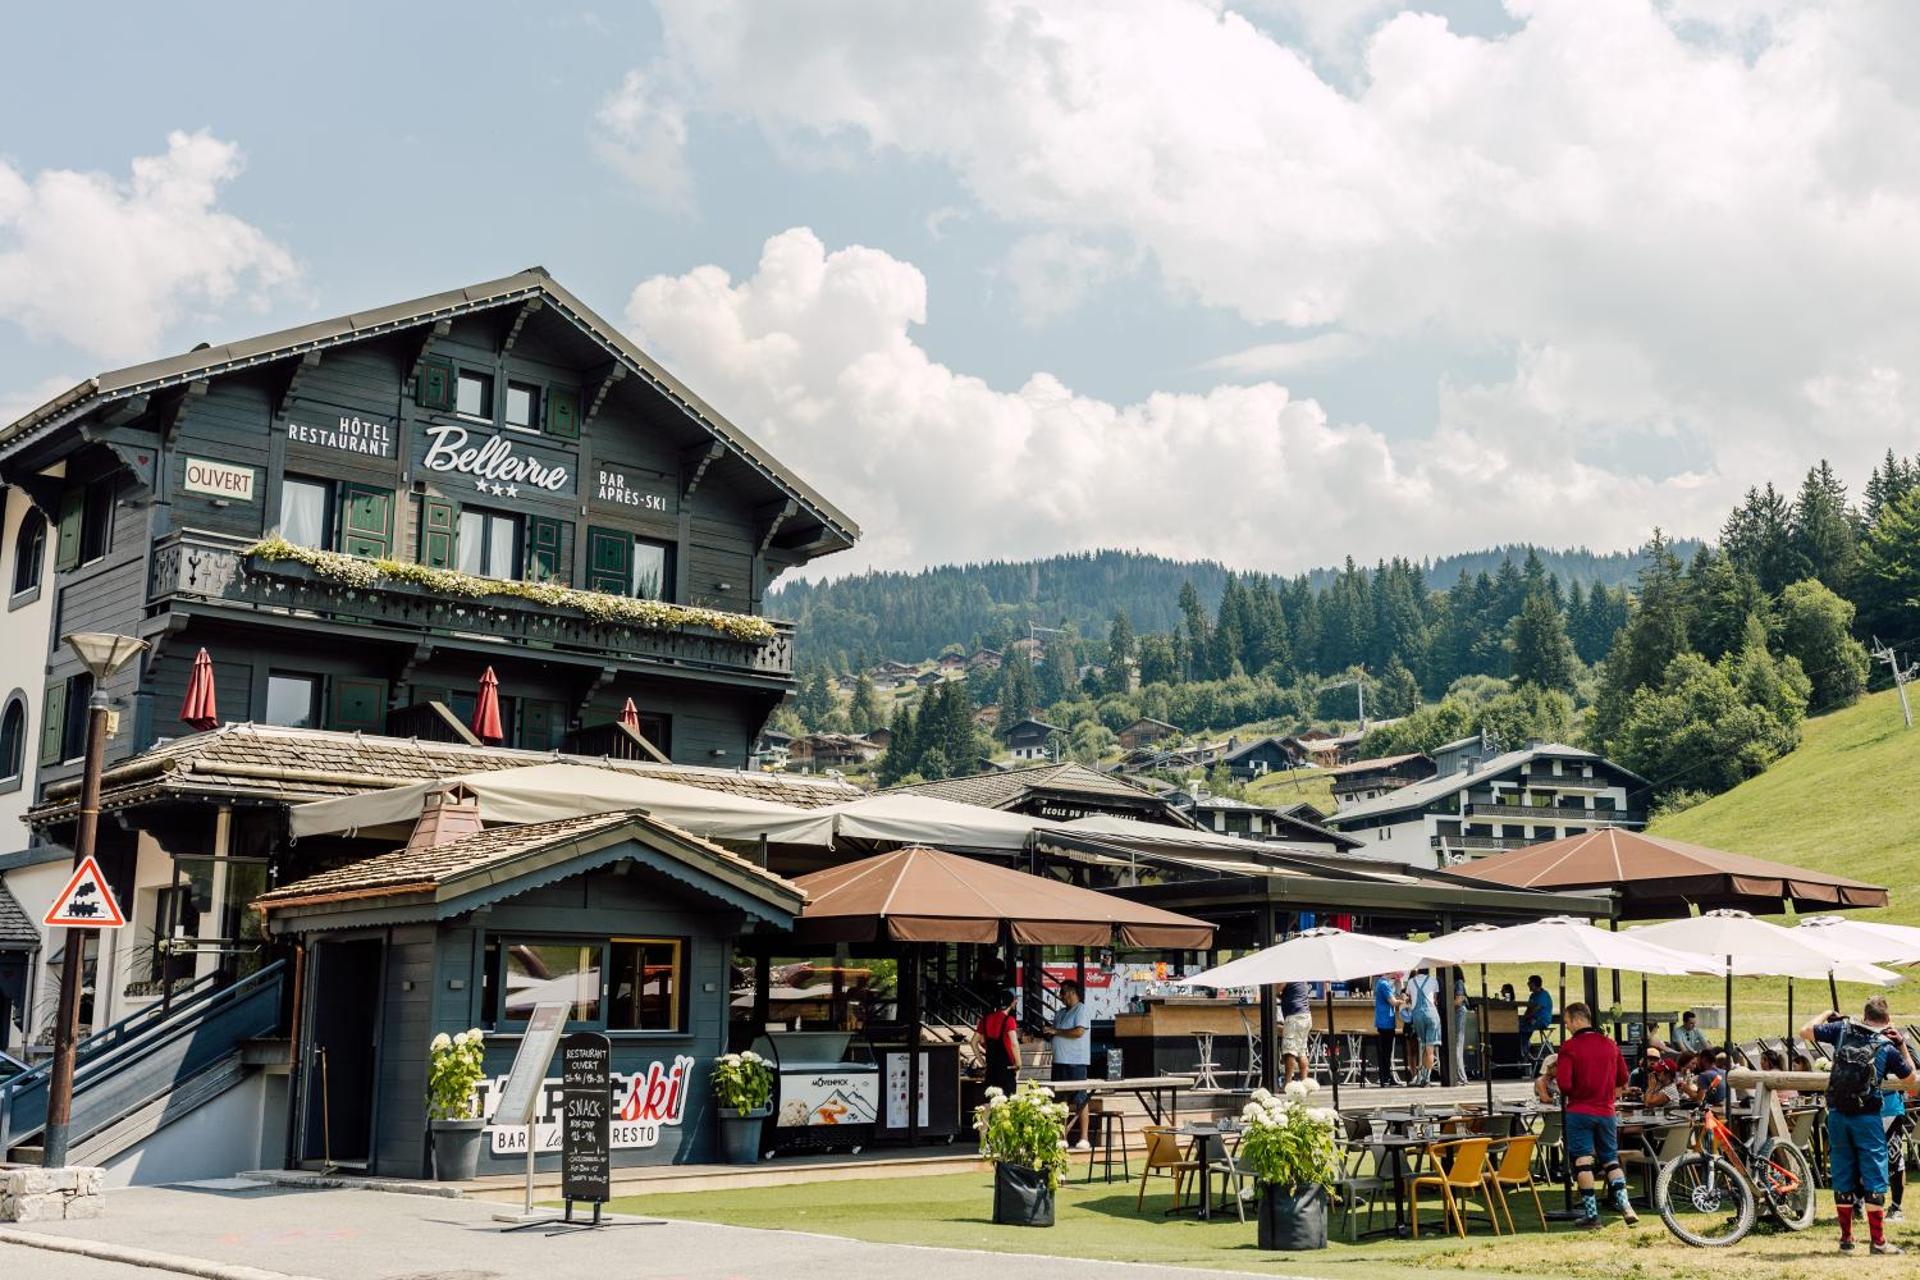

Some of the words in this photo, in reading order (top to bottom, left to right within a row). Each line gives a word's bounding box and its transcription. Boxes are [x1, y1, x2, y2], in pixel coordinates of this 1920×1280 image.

[288, 424, 389, 457] RESTAURANT
[339, 416, 390, 442] HÔTEL
[424, 425, 568, 490] Bellevue
[187, 466, 251, 492] OUVERT
[599, 470, 624, 488] BAR
[598, 485, 666, 511] APRÈS-SKI
[571, 1060, 599, 1071] OUVERT
[568, 1099, 601, 1118] SNACK
[498, 1131, 527, 1148] BAR
[612, 1125, 655, 1143] RESTO
